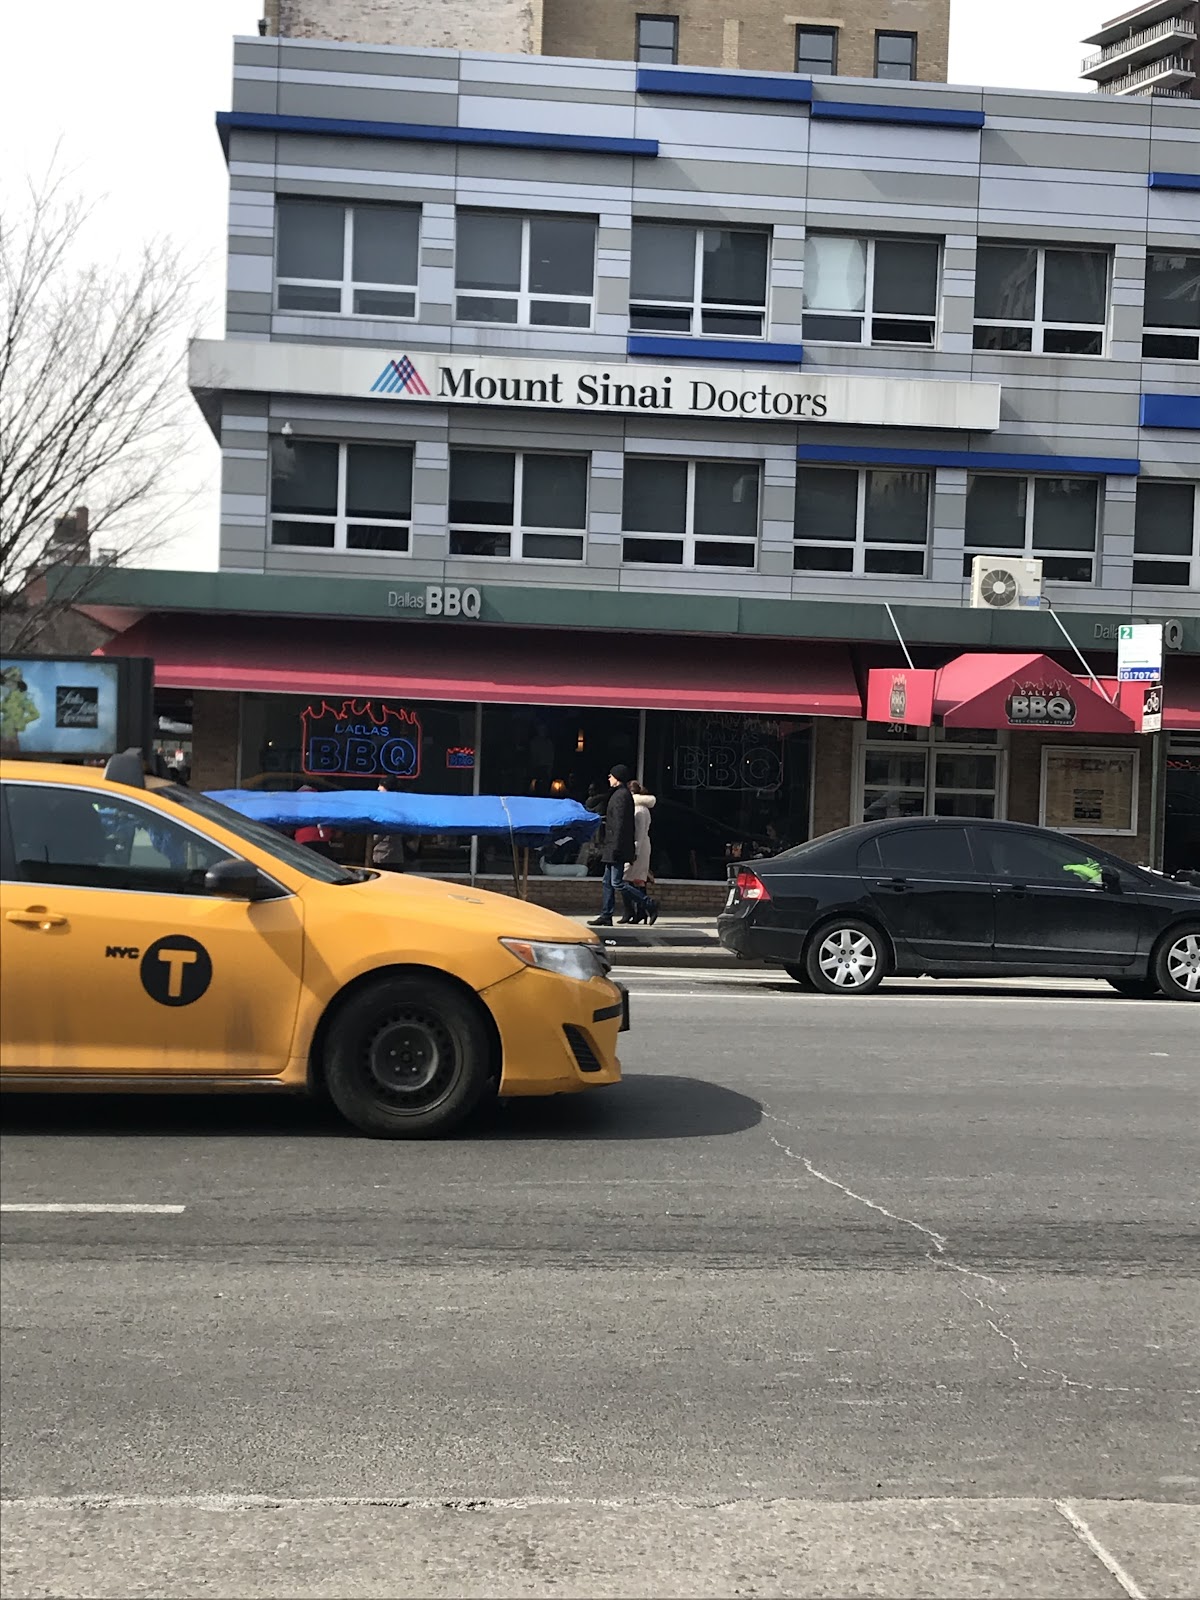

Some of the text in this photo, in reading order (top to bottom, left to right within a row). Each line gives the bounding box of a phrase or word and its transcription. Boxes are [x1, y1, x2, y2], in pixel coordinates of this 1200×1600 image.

[437, 366, 828, 417] Mount Sinai Doctors
[388, 581, 481, 619] Dallas BBQ
[1122, 627, 1131, 639] 2
[1012, 696, 1072, 719] BBQ
[310, 737, 417, 775] BBQ
[105, 946, 198, 998] NYC T
